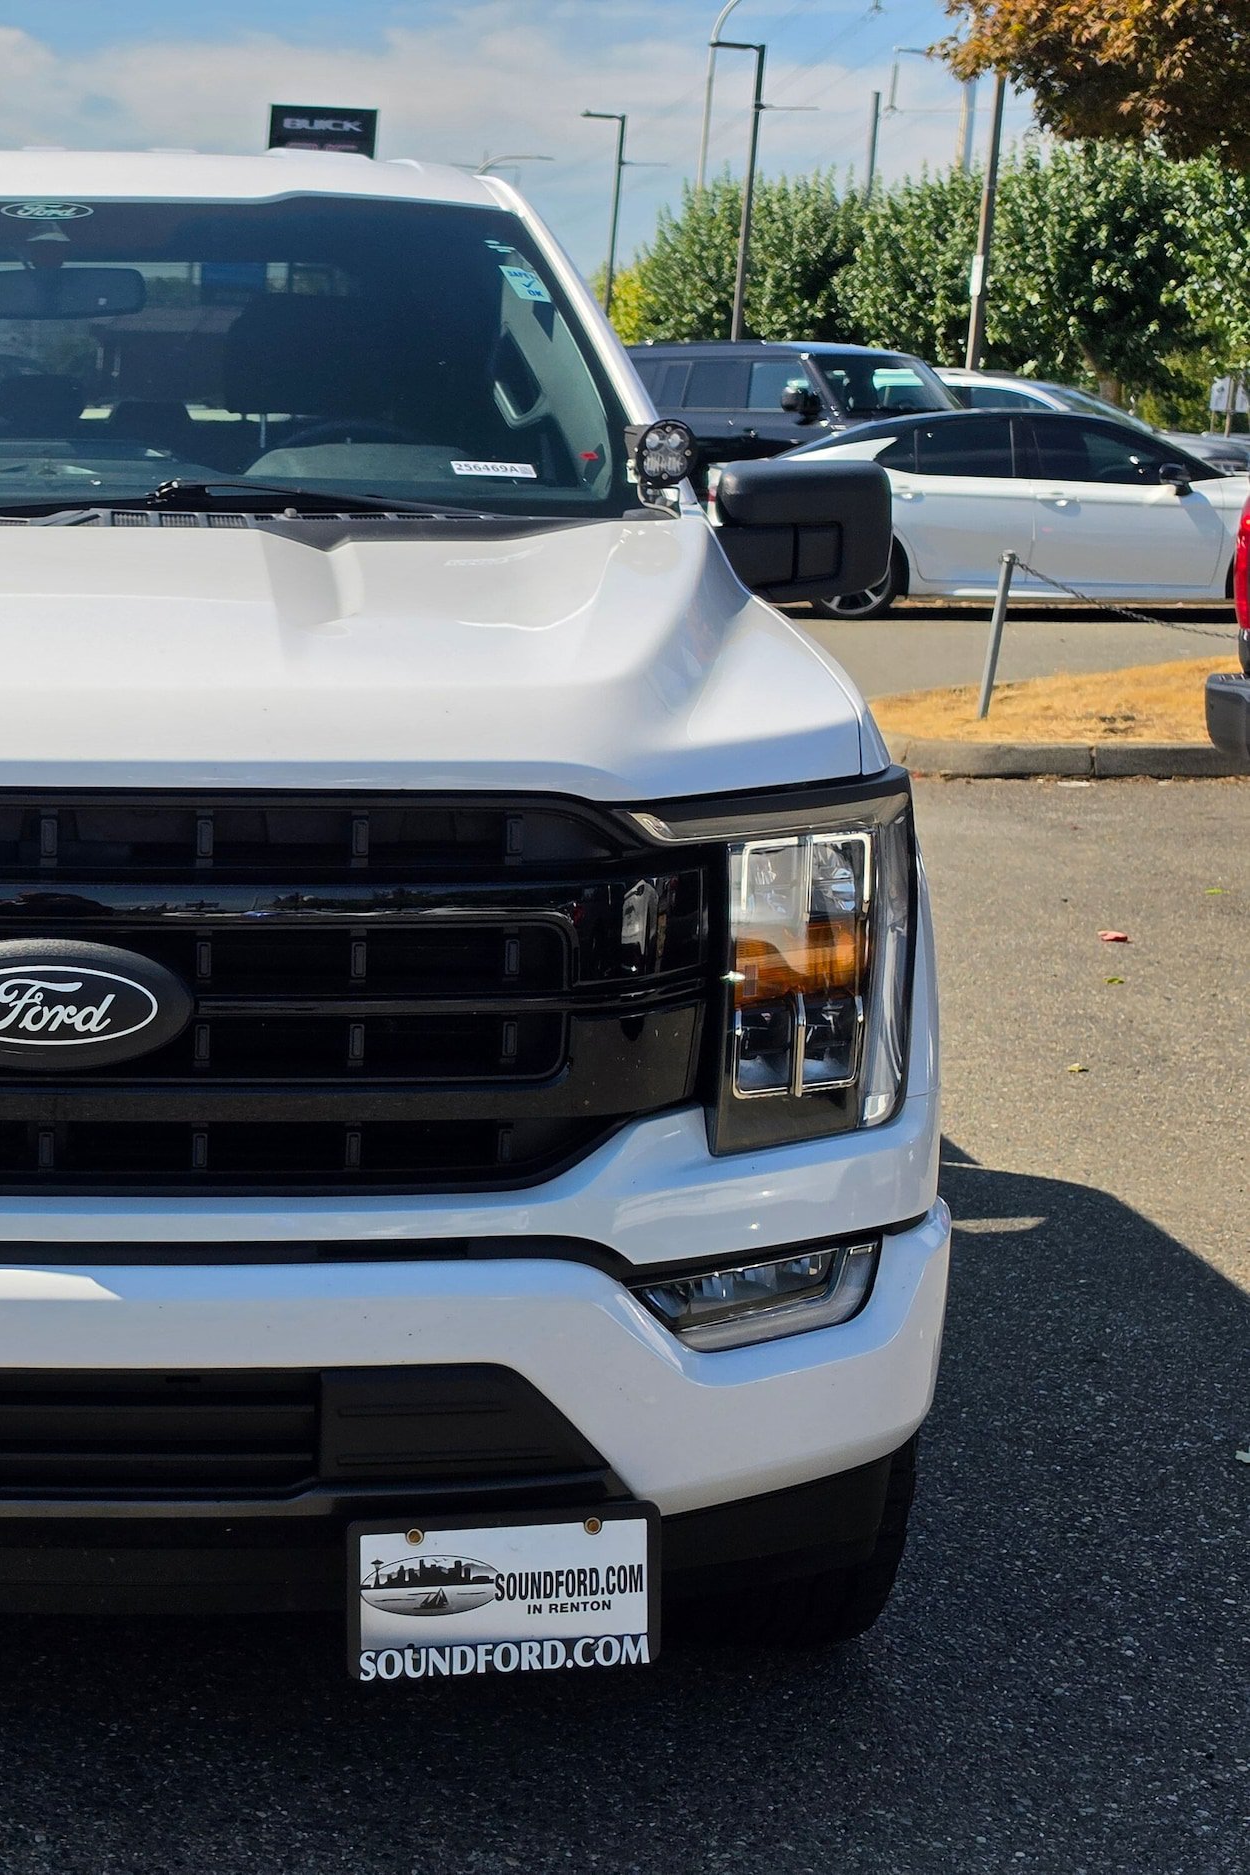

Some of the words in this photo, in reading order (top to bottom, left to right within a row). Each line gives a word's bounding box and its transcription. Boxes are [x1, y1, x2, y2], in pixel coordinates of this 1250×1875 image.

[283, 117, 363, 132] BUICK
[16, 204, 78, 217] Ford
[527, 289, 543, 297] OK
[494, 1564, 644, 1601] SOUNDFORD.COM
[527, 1604, 543, 1615] IN
[549, 1600, 612, 1614] RENTON
[359, 1634, 650, 1682] SOUNDFORD.COM
